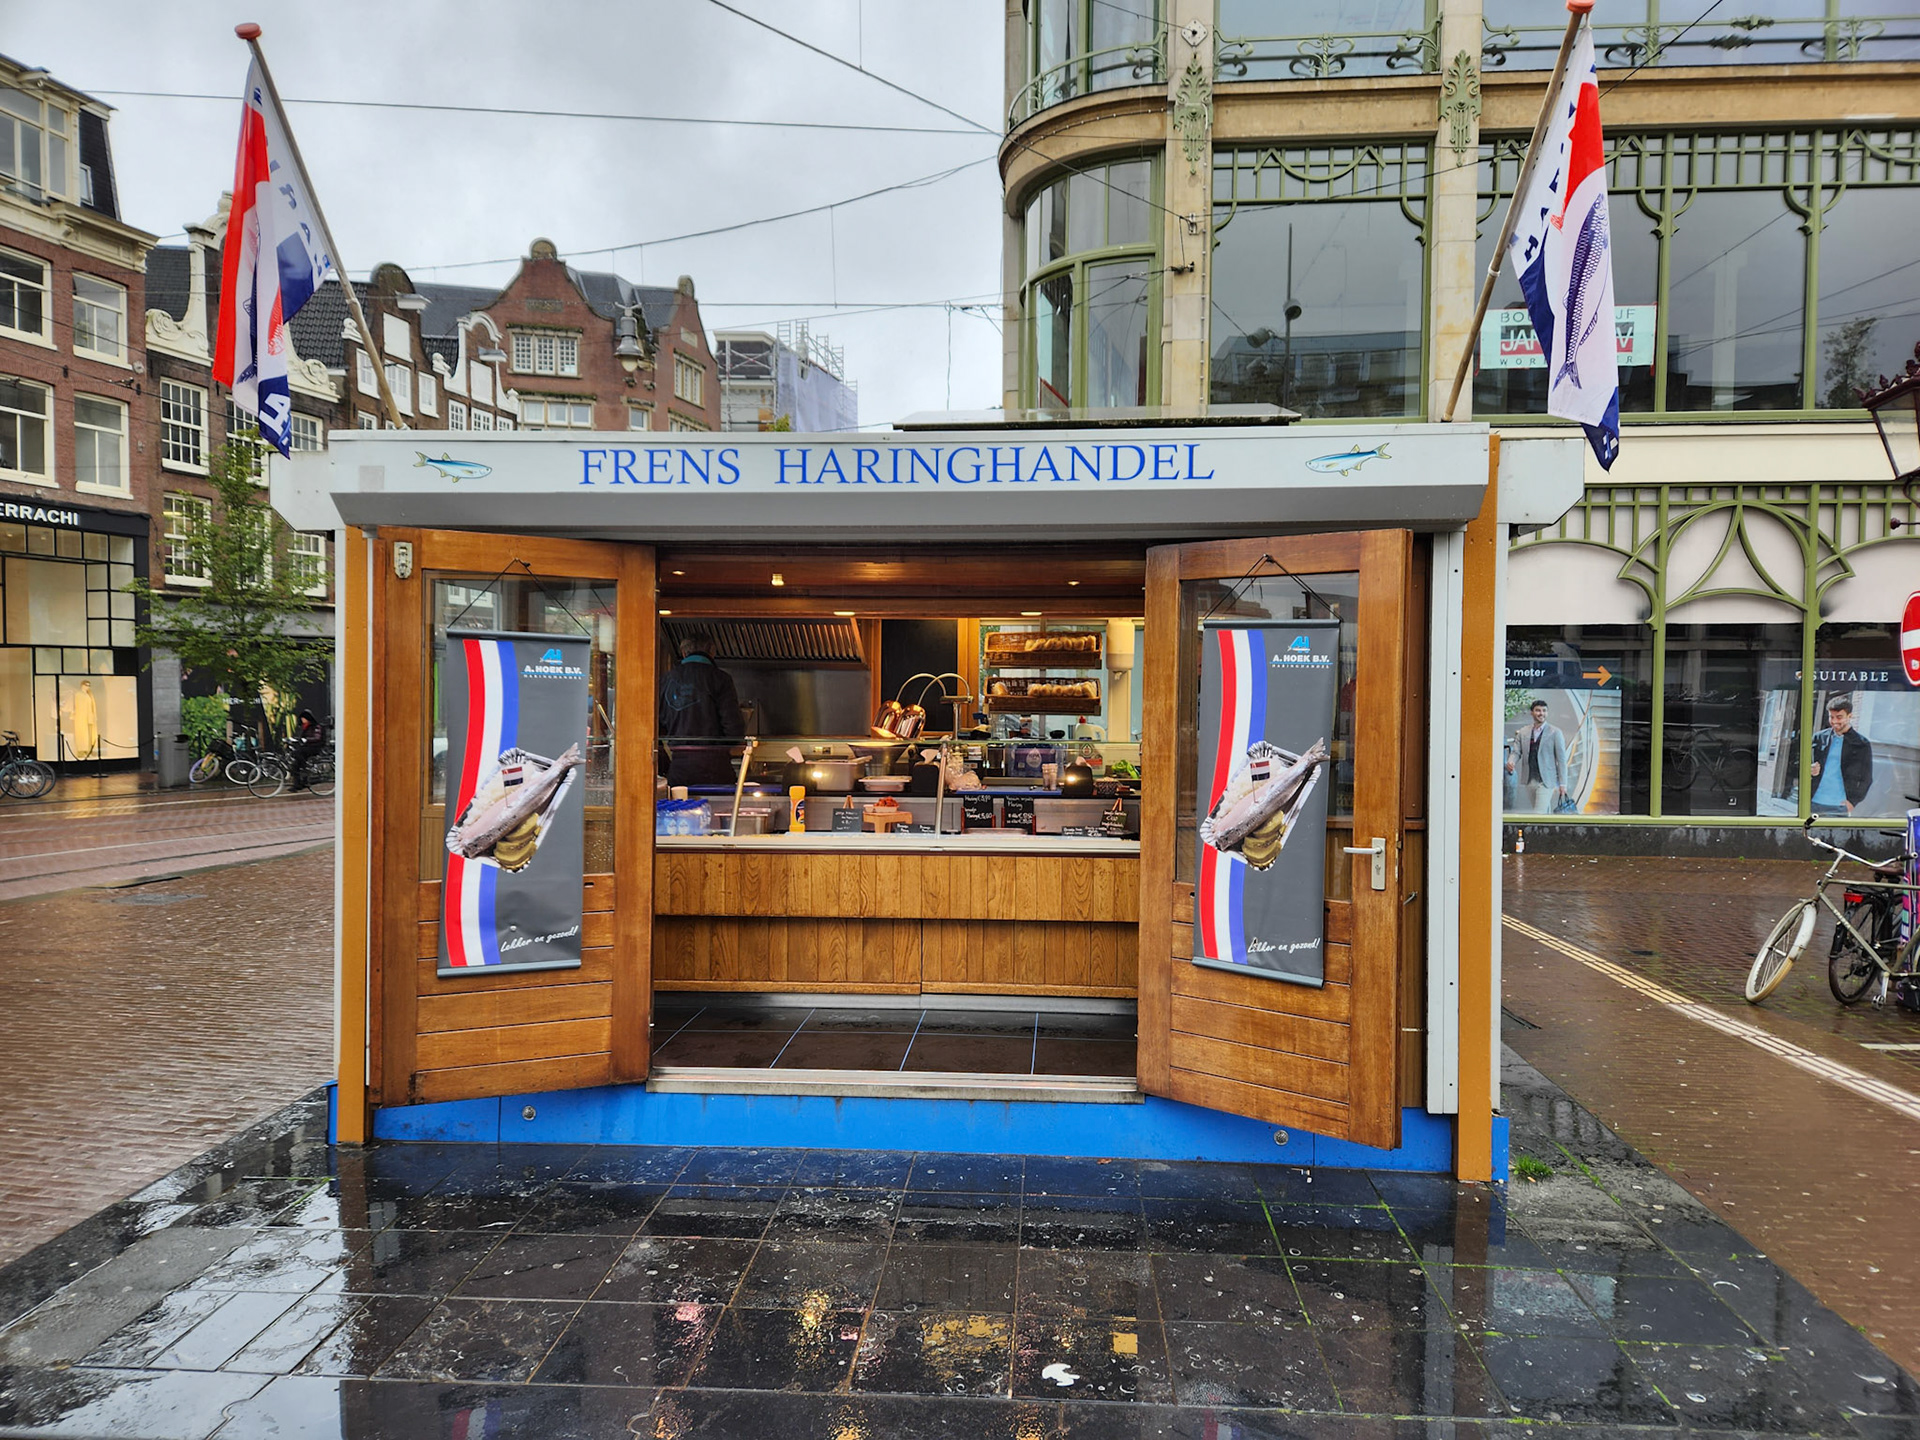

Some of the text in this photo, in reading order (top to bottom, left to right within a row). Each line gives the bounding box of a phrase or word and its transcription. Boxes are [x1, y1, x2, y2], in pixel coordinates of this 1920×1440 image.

[578, 443, 1215, 485] FRENS HARINGHANDEL
[1283, 654, 1311, 662] HOEK
[1312, 654, 1330, 663] B.V.
[535, 665, 564, 674] HOEK
[564, 666, 582, 675] B.V.
[1513, 668, 1546, 677] meter
[500, 937, 532, 953] Lekker
[534, 935, 545, 943] en
[1289, 937, 1321, 954] gezond!
